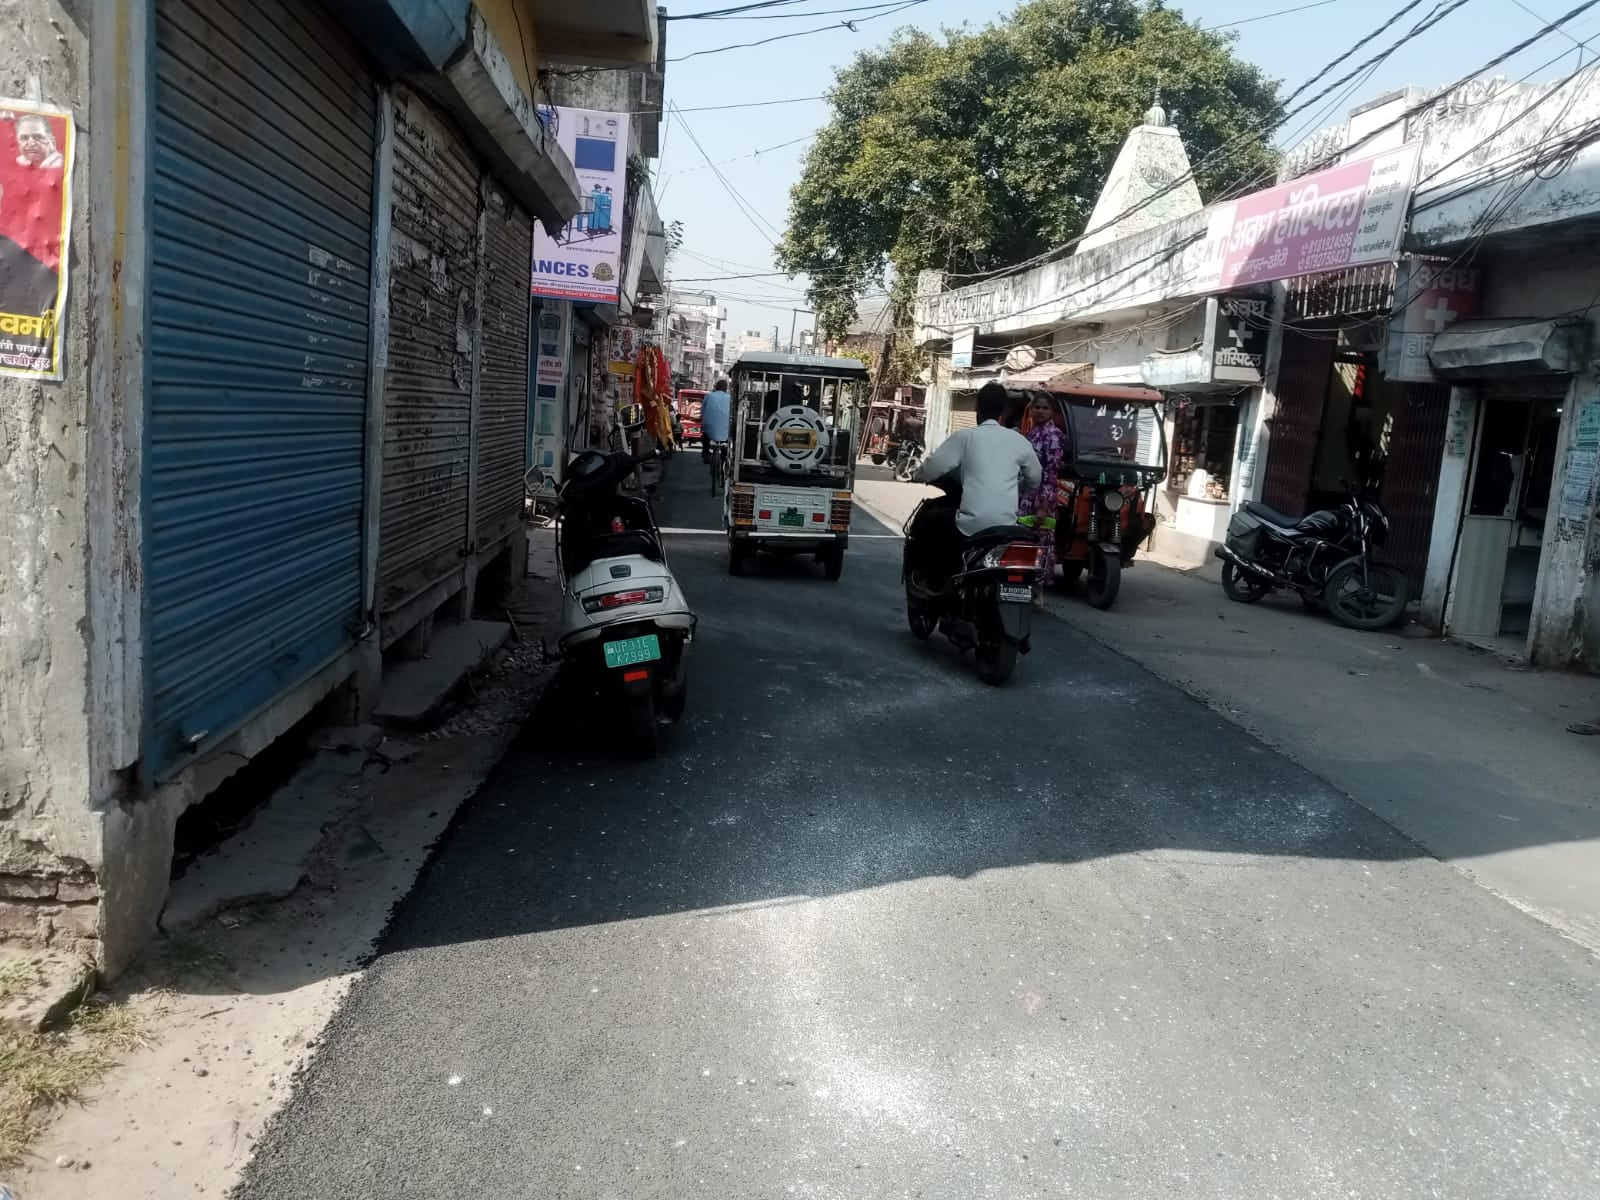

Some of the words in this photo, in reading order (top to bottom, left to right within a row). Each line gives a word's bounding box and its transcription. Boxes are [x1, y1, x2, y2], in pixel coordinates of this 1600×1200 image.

[1231, 212, 1278, 252] अवध
[1274, 184, 1367, 244] हॉस्पिटल
[1220, 299, 1268, 317] अवध
[1215, 346, 1263, 367] हॉस्पिटल
[614, 638, 649, 653] UP31C
[616, 649, 651, 665] K7999
